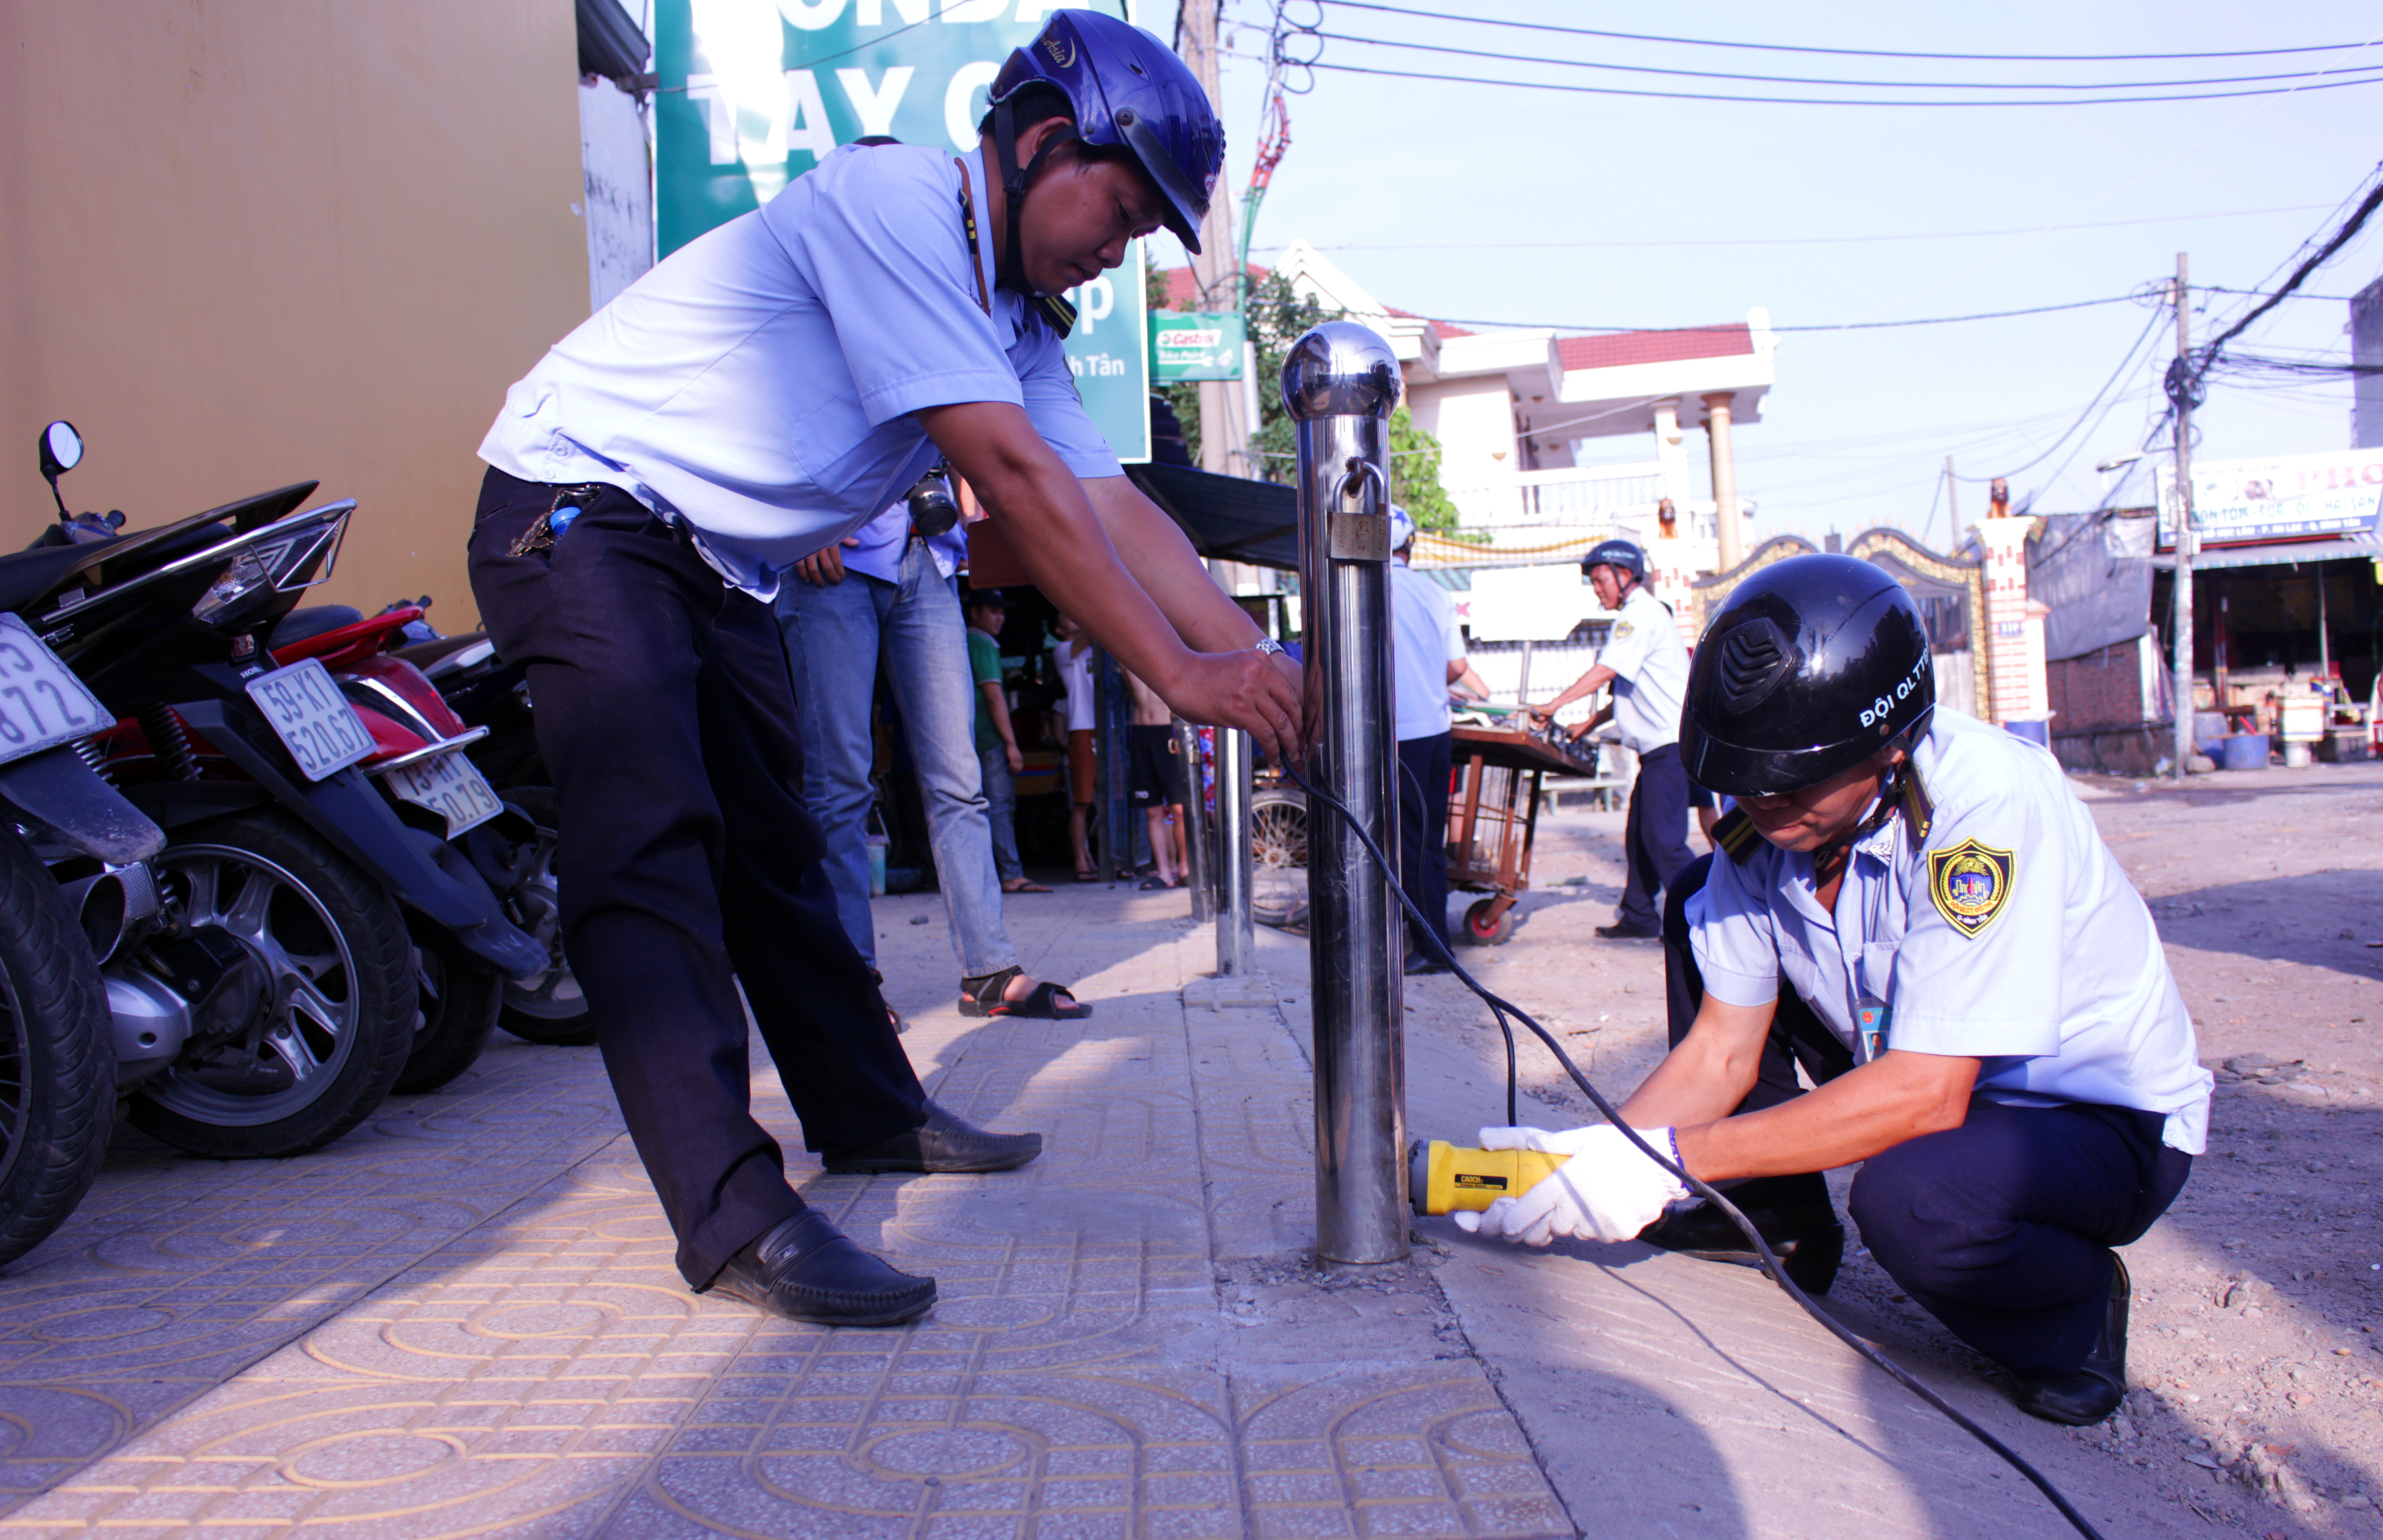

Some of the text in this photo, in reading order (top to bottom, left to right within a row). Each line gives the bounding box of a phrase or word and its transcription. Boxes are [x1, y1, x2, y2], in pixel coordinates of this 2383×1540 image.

[1043, 40, 1066, 64] Asia
[1173, 333, 1214, 345] Castrol
[1086, 352, 1125, 376] Tân
[262, 669, 332, 724] 59-K1
[1860, 694, 1895, 727] ĐỘI
[286, 708, 364, 770] 520.67
